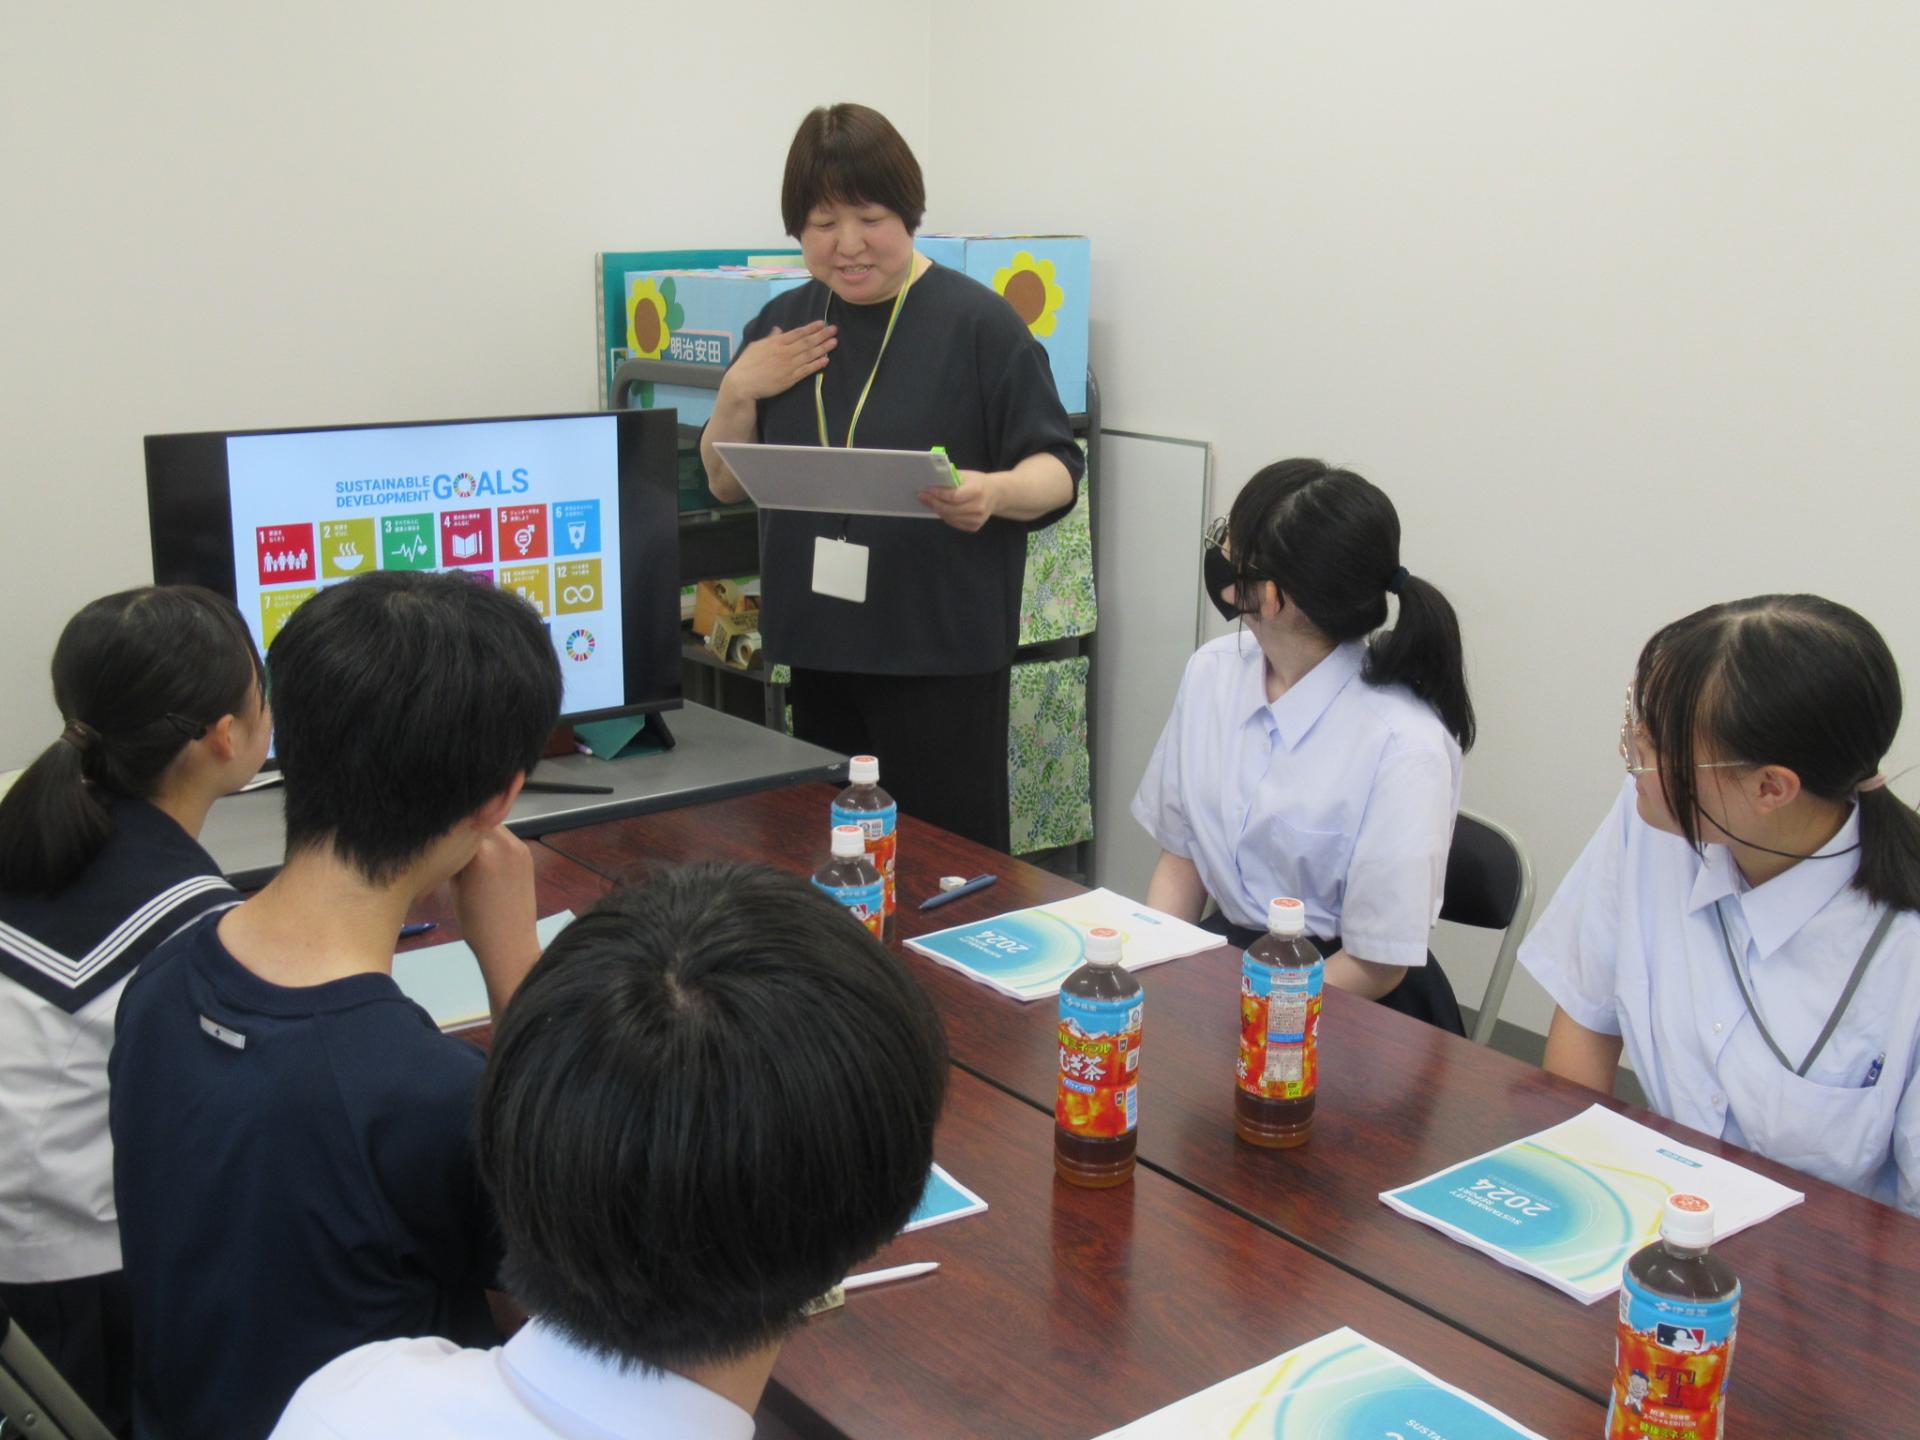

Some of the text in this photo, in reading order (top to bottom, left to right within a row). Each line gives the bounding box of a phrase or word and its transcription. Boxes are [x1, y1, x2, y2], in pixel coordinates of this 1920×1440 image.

[670, 336, 721, 364] 明治安田
[336, 475, 431, 493] SUSTAINABLE
[433, 468, 529, 500] GOALS
[336, 489, 431, 508] DEVELOPMENT
[501, 510, 508, 524] 5
[555, 505, 563, 519] 6
[384, 520, 393, 534] 3
[443, 515, 451, 529] 4
[260, 530, 265, 545] 1
[323, 525, 331, 539] 2
[502, 571, 512, 585] 11
[556, 565, 567, 579] 12
[265, 595, 271, 609] 7
[976, 930, 1029, 954] 2024
[1059, 1046, 1106, 1081] むぎ茶
[1470, 1178, 1551, 1217] 2024
[1448, 1189, 1522, 1225] SUSTAINABILITY
